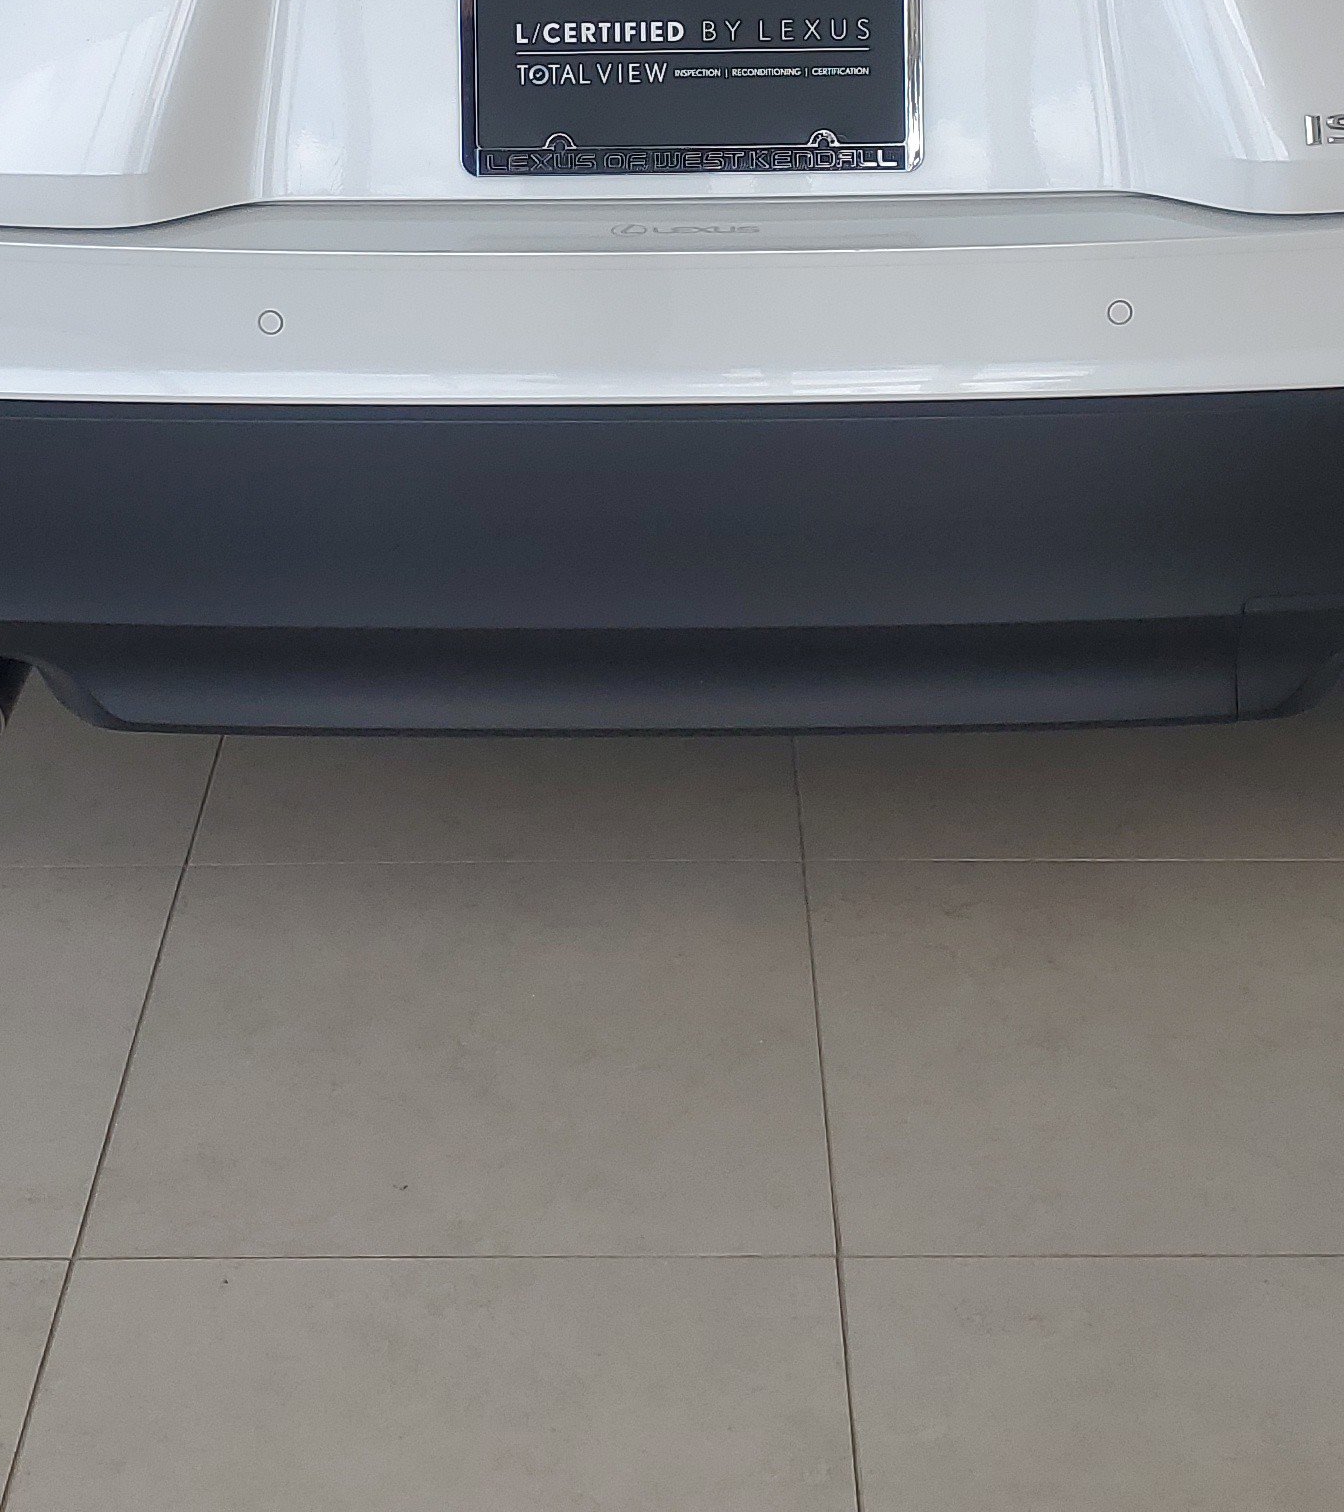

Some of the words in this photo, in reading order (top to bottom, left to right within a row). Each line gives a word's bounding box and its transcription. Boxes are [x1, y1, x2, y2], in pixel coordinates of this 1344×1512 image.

[515, 21, 685, 44] L/CERTIFIED
[702, 20, 741, 42] BY
[758, 18, 870, 40] LEXUS
[516, 63, 592, 86] TOTAL
[596, 62, 668, 84] VIEW
[674, 68, 721, 78] INSPECTION
[731, 67, 802, 77] RECONDITIONING
[811, 66, 870, 76] CERTIFICATION
[485, 153, 597, 171] LEXUS
[603, 152, 647, 170] OF
[654, 151, 745, 170] WEST
[748, 149, 898, 169] KENDALL
